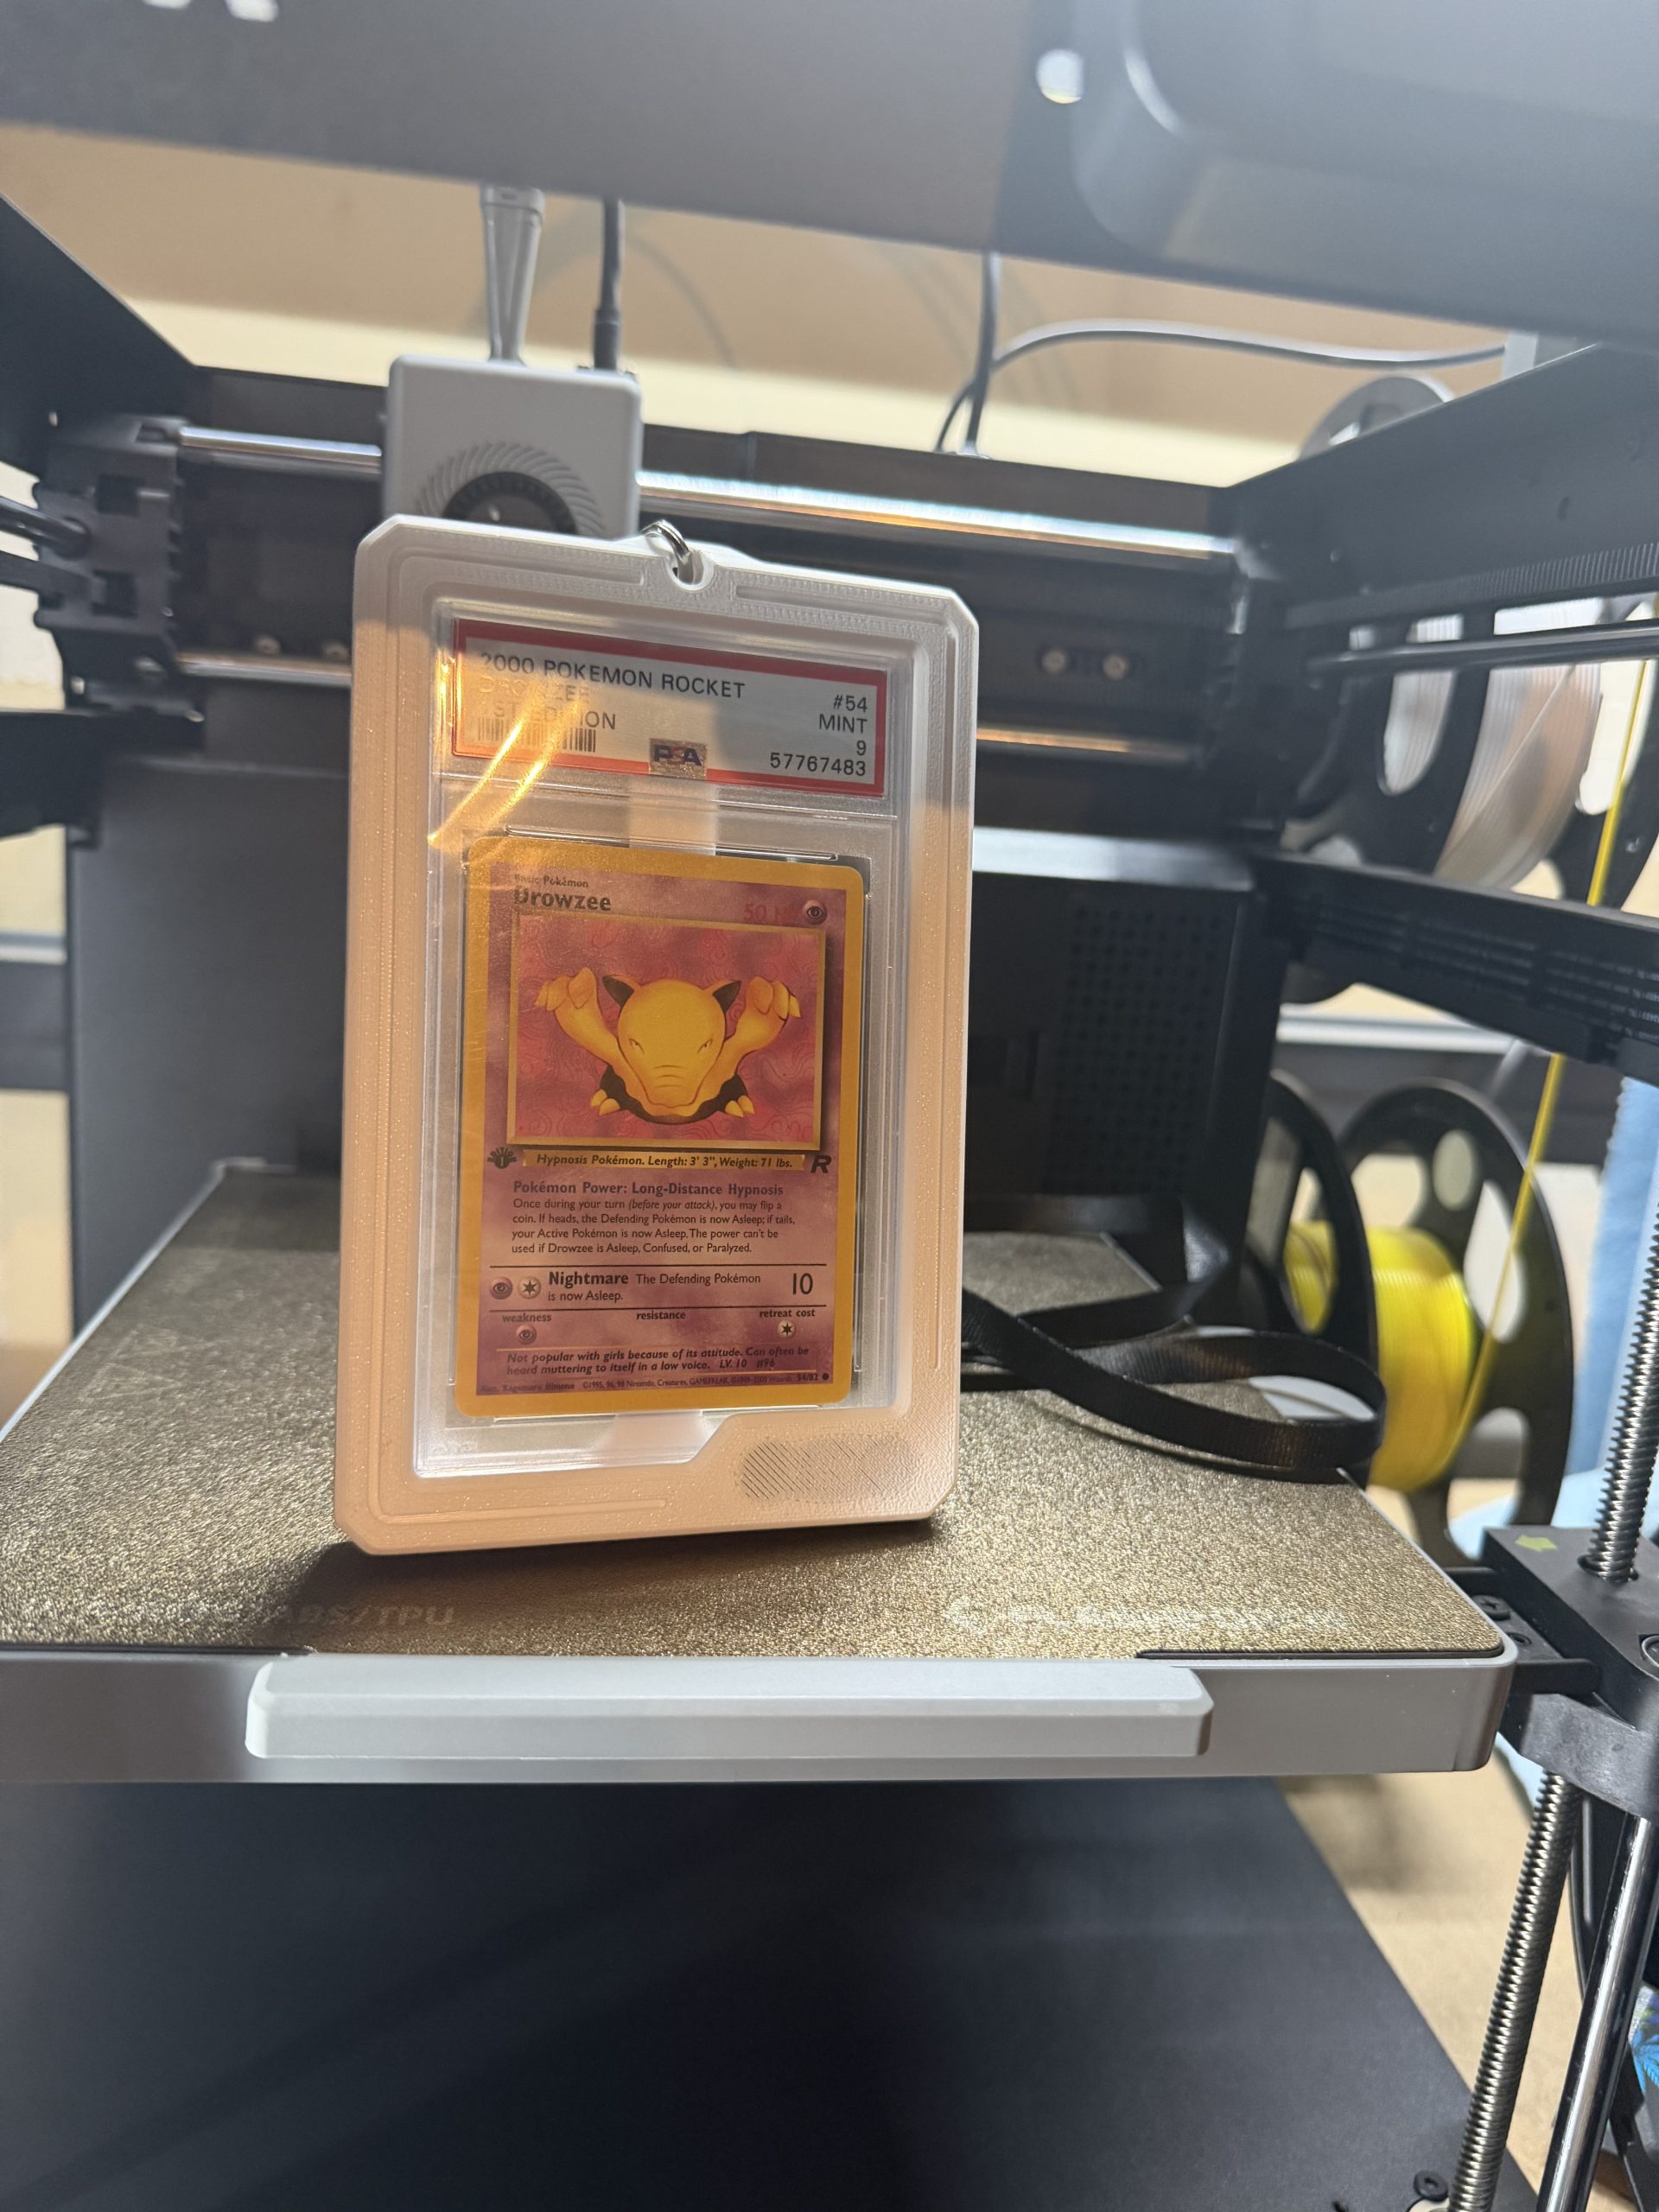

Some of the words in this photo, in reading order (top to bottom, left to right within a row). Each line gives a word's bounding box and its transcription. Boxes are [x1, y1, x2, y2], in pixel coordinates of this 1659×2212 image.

[480, 652, 535, 675] 2000
[543, 659, 652, 690] POKEMON
[661, 673, 746, 698] ROCKET
[832, 694, 868, 713] #54
[818, 713, 868, 734] MINT
[653, 744, 702, 767] PSA
[855, 740, 868, 756] 9
[770, 751, 867, 777] 57767483
[536, 1153, 588, 1167] Hypnosis
[592, 1154, 645, 1166] Pokémon.
[647, 1155, 688, 1168] Length:
[690, 1156, 700, 1166] 3'
[719, 1157, 759, 1169] Weight:
[760, 1158, 772, 1167] 71
[775, 1158, 792, 1168] lbs.
[512, 1180, 576, 1194] Pokémon
[582, 1181, 627, 1194] Power:
[632, 1181, 722, 1198] Long-Distance
[728, 1183, 784, 1198] Hypnosis
[512, 1198, 540, 1209] Once
[544, 1198, 575, 1211] during
[579, 1200, 601, 1211] your
[604, 1199, 625, 1209] turn
[628, 1198, 659, 1211] (before
[662, 1201, 681, 1211] your
[720, 1202, 735, 1211] you
[740, 1203, 757, 1211] may
[760, 1200, 774, 1211] flip
[512, 1213, 536, 1224] coin.
[538, 1213, 545, 1224] If
[548, 1213, 579, 1225] heads,
[582, 1213, 598, 1224] the
[601, 1213, 649, 1225] Defending
[652, 1213, 696, 1224] Pokémon
[700, 1214, 707, 1224] is
[766, 1214, 773, 1224] if
[512, 1230, 534, 1241] your
[537, 1228, 569, 1238] Active
[572, 1228, 618, 1238] Pokémon
[621, 1229, 628, 1238] is
[632, 1230, 652, 1238] now
[655, 1228, 688, 1240] Asleep.
[690, 1228, 708, 1238] The
[710, 1230, 741, 1240] power
[743, 1228, 765, 1238] can't
[767, 1228, 779, 1238] be
[512, 1243, 535, 1253] used
[538, 1243, 545, 1253] if
[548, 1243, 594, 1253] Drowzee
[597, 1243, 604, 1253] is
[606, 1243, 640, 1255] Asleep,
[643, 1243, 690, 1254] Confused,
[693, 1244, 703, 1253] or
[707, 1243, 752, 1255] Paralyzed.
[549, 1271, 629, 1288] Nightmare
[636, 1274, 656, 1285] The
[659, 1274, 711, 1286] Defending
[714, 1273, 761, 1284] Pokémon
[791, 1272, 814, 1295] 10
[548, 1291, 556, 1301] is
[561, 1292, 583, 1301] now
[585, 1290, 624, 1303] Asleep.
[502, 1313, 552, 1323] weakness
[636, 1309, 686, 1320] resistance
[760, 1309, 792, 1318] retreat
[796, 1308, 816, 1318] cost
[507, 1353, 529, 1364] Not
[531, 1351, 574, 1364] popular
[577, 1351, 600, 1361] with
[604, 1351, 624, 1363] girls
[627, 1349, 669, 1360] because
[672, 1348, 684, 1360] of
[686, 1349, 698, 1357] its
[701, 1347, 743, 1357] attitude.
[746, 1346, 766, 1357] Can
[769, 1346, 794, 1357] often
[798, 1346, 810, 1356] be
[506, 1365, 537, 1376] heard
[541, 1364, 592, 1376] muttering
[610, 1362, 636, 1374] itself
[638, 1363, 647, 1371] in
[660, 1361, 679, 1370] low
[682, 1361, 710, 1370] voice.
[719, 1359, 733, 1369] LV.
[736, 1359, 747, 1369] 10
[756, 1358, 775, 1369] #96
